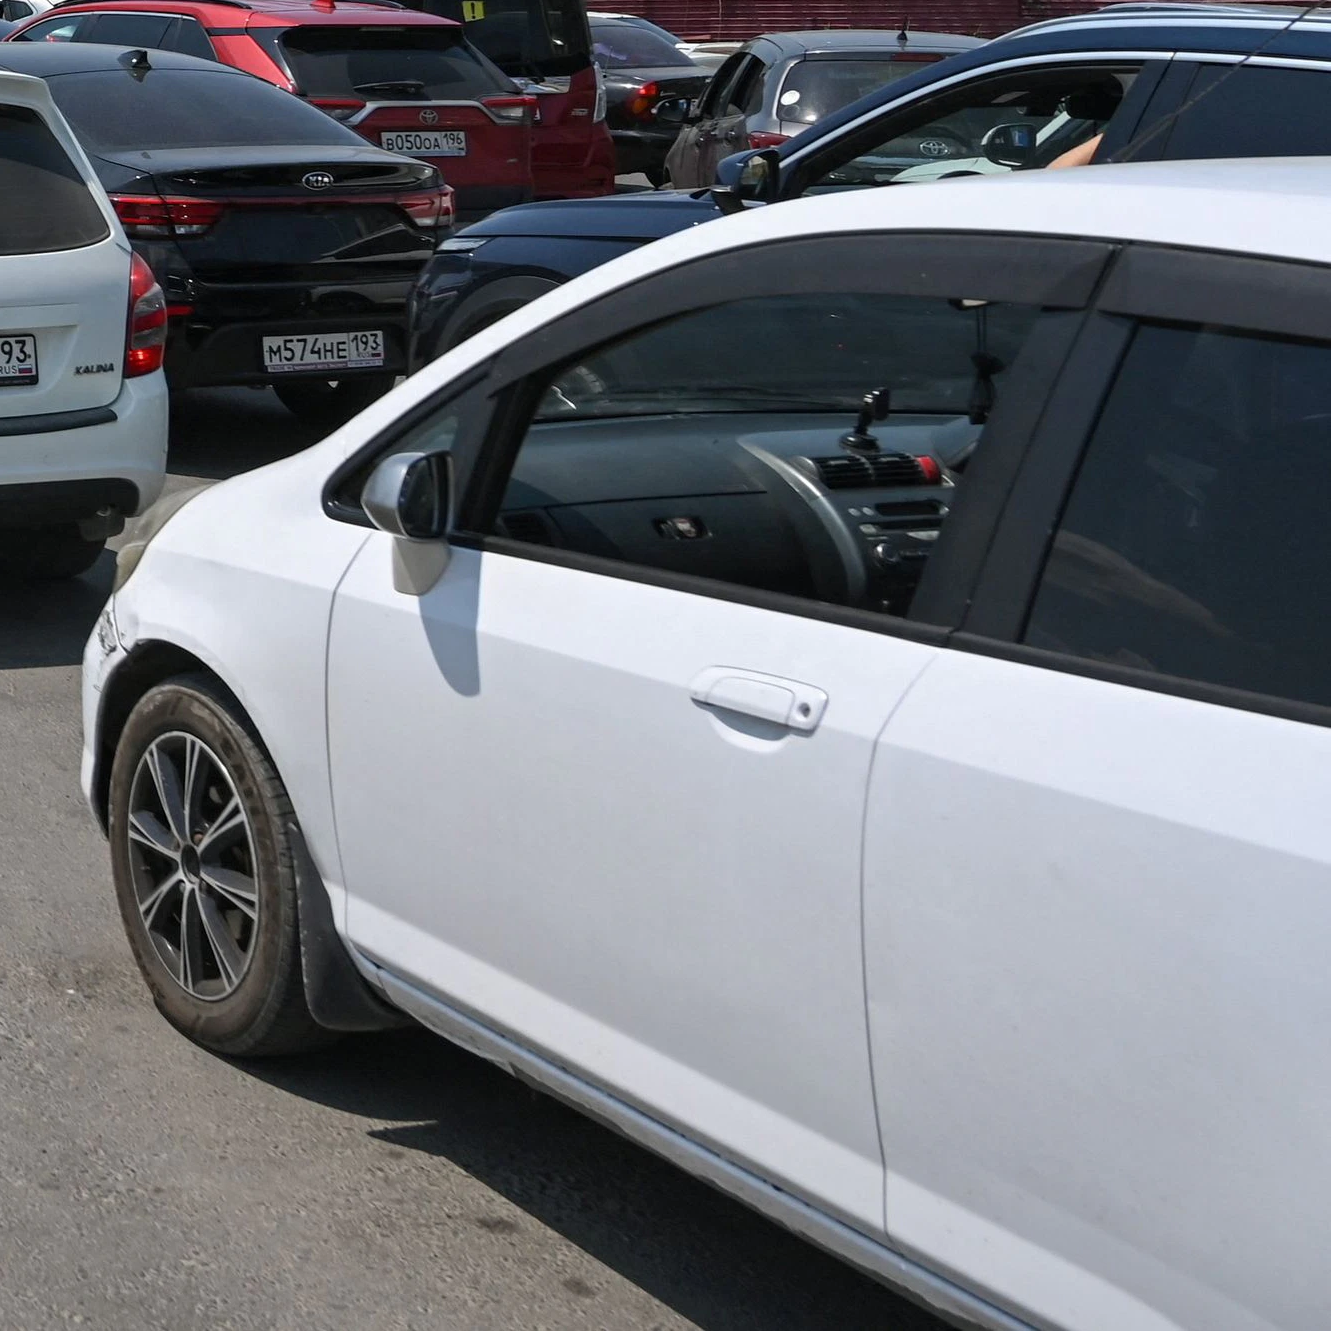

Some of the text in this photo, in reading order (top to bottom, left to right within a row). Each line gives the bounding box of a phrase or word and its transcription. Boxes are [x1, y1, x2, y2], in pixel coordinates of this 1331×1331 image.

[268, 333, 381, 363] М574НЕ 193
[74, 362, 115, 376] KALINA
